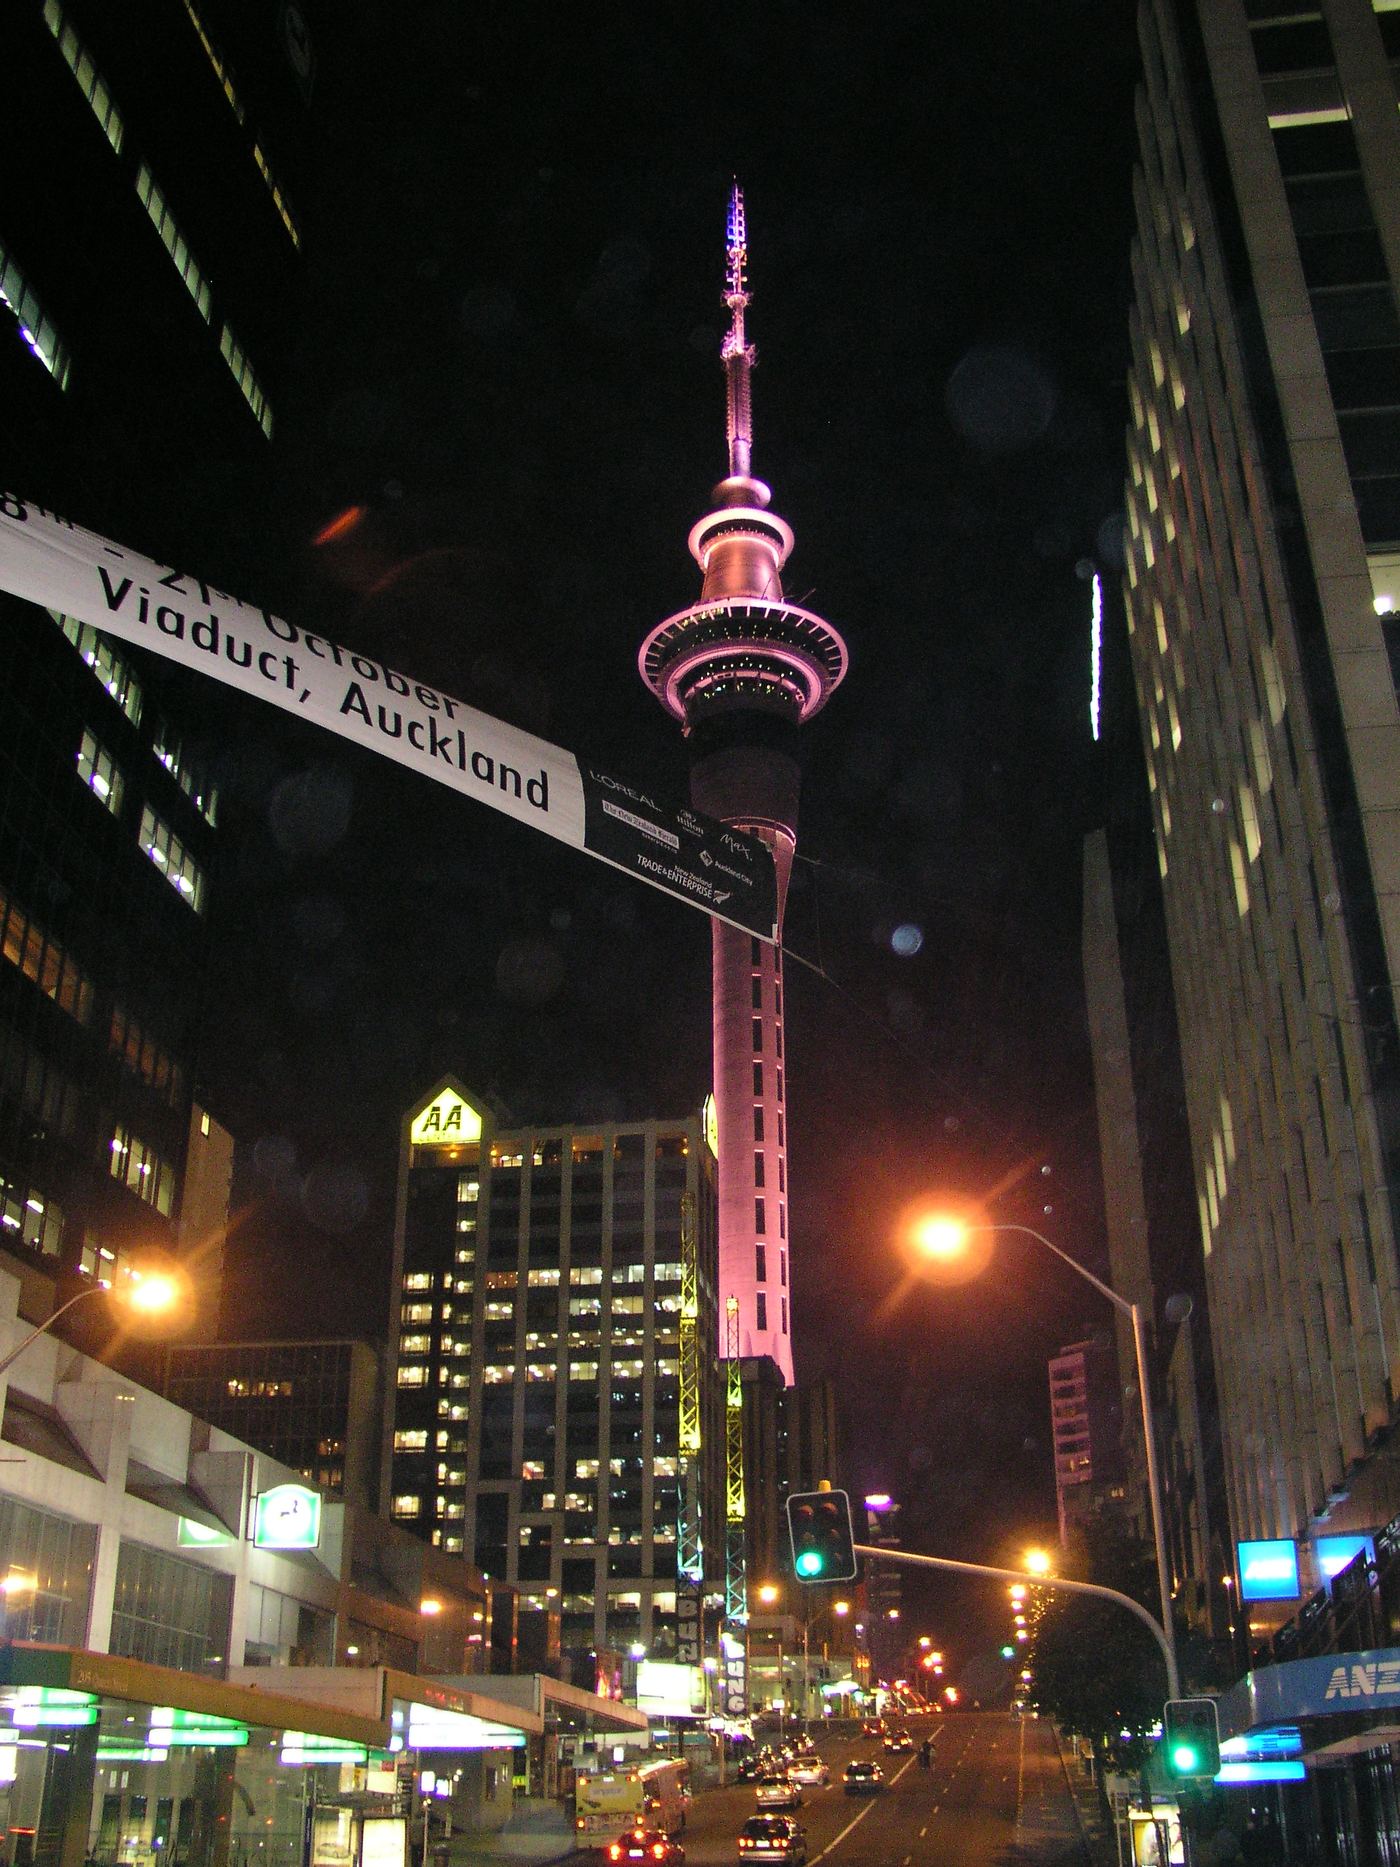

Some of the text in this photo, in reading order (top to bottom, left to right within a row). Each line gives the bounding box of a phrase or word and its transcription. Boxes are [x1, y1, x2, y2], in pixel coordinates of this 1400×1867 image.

[262, 610, 459, 720] October
[97, 565, 549, 812] Viaduct, Auckland
[677, 815, 704, 835] Hilton
[674, 865, 713, 889] New Zealand
[421, 1104, 462, 1132] AA
[1324, 1661, 1400, 1701] ANZ
